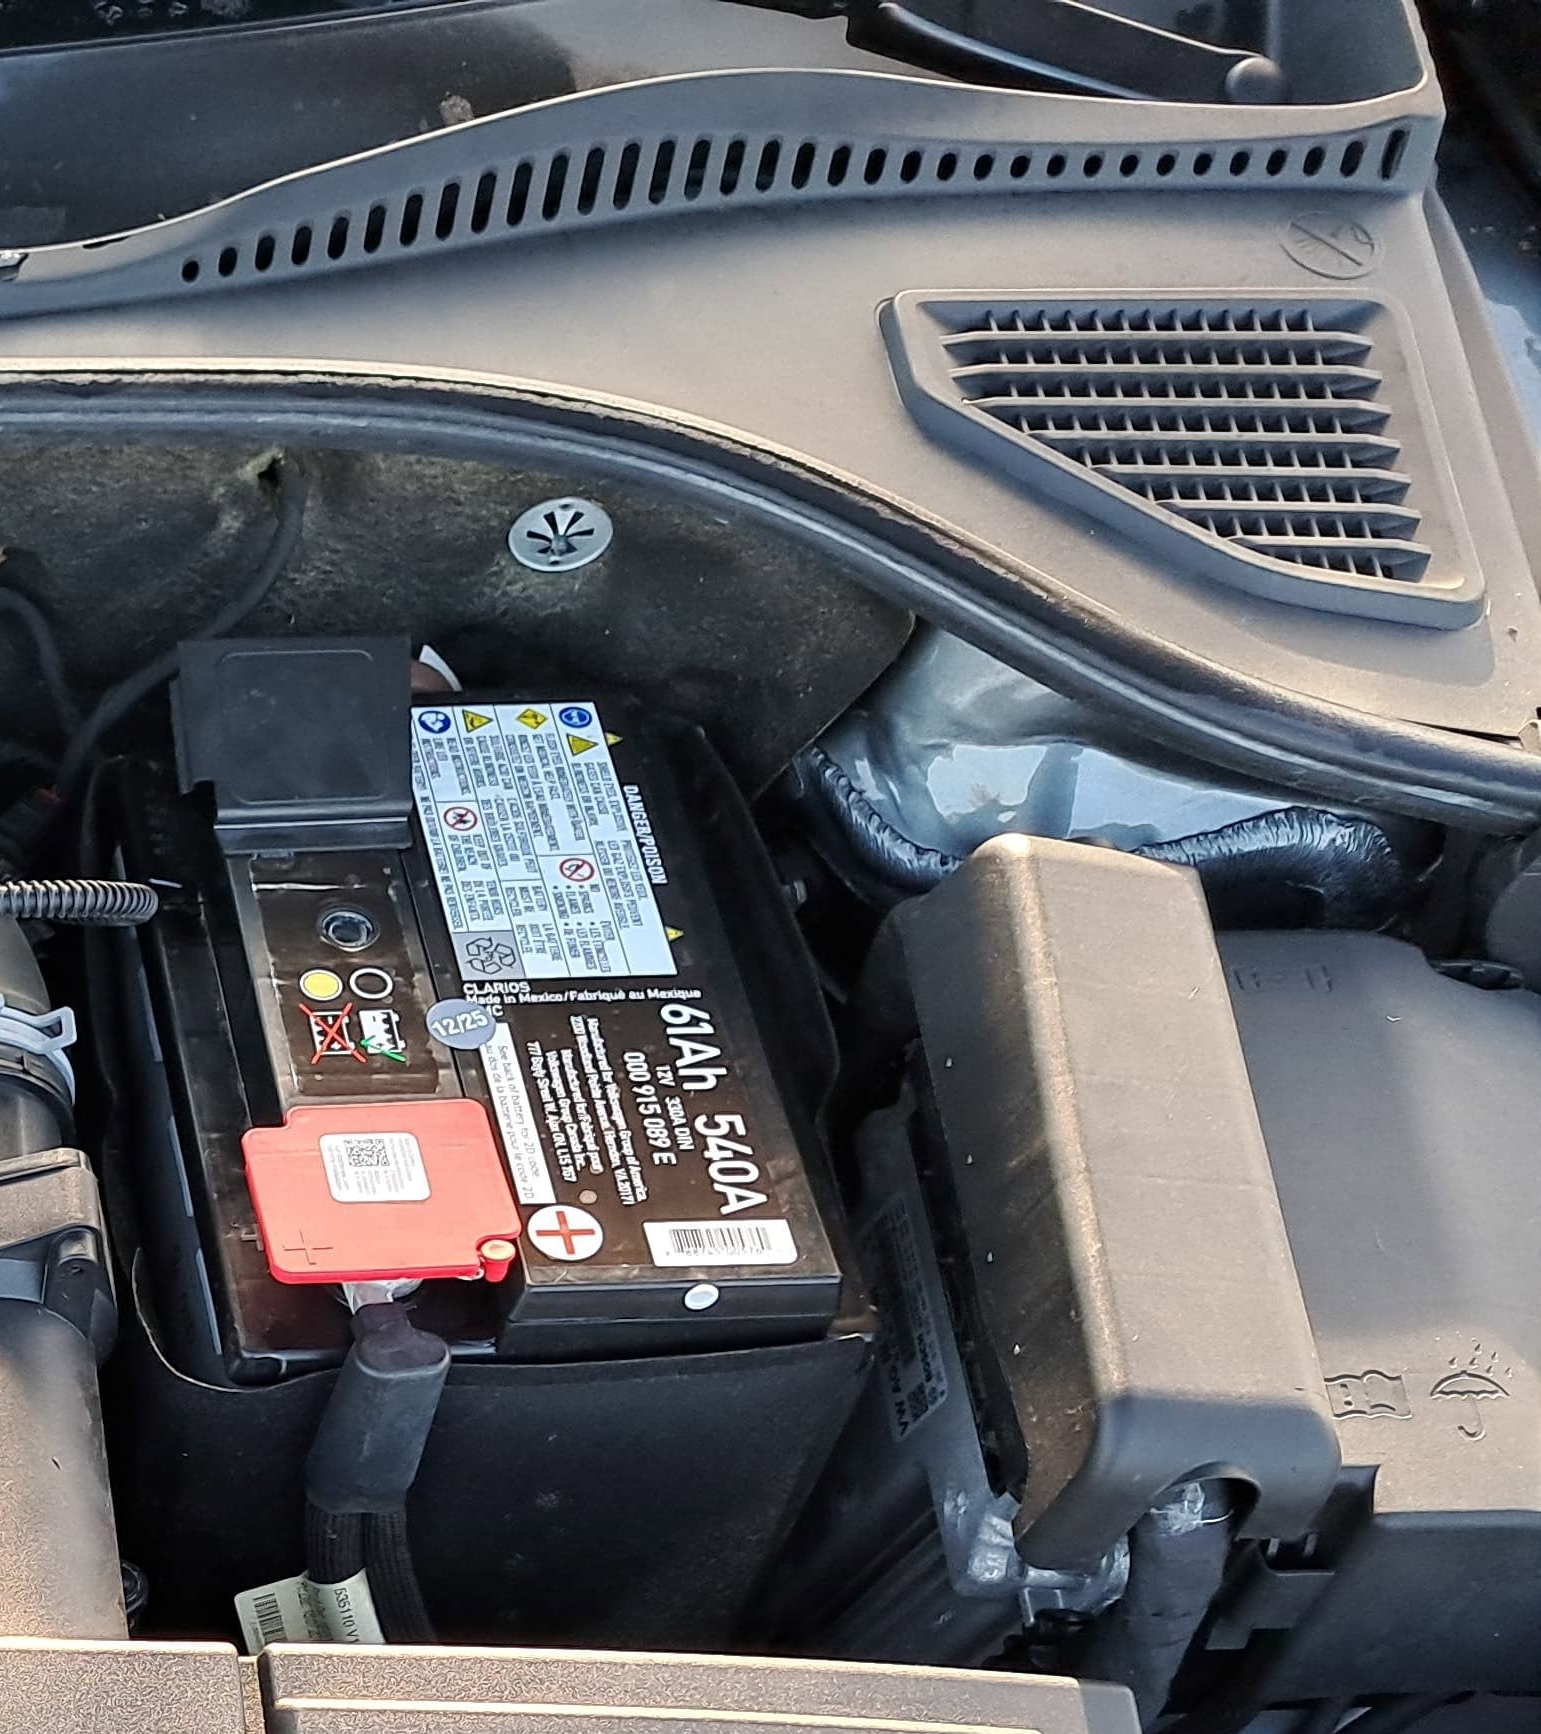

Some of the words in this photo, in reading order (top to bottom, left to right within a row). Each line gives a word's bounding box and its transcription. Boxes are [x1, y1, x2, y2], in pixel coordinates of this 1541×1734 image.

[462, 982, 531, 994] CLARIOS
[431, 1009, 488, 1037] 12/25
[622, 1052, 651, 1081] 000
[657, 1065, 675, 1085] 12V
[638, 1085, 662, 1114] 915
[660, 1003, 728, 1090] 61Ah
[694, 1114, 768, 1216] 540A
[644, 1119, 671, 1148] 089
[652, 1152, 677, 1165] E
